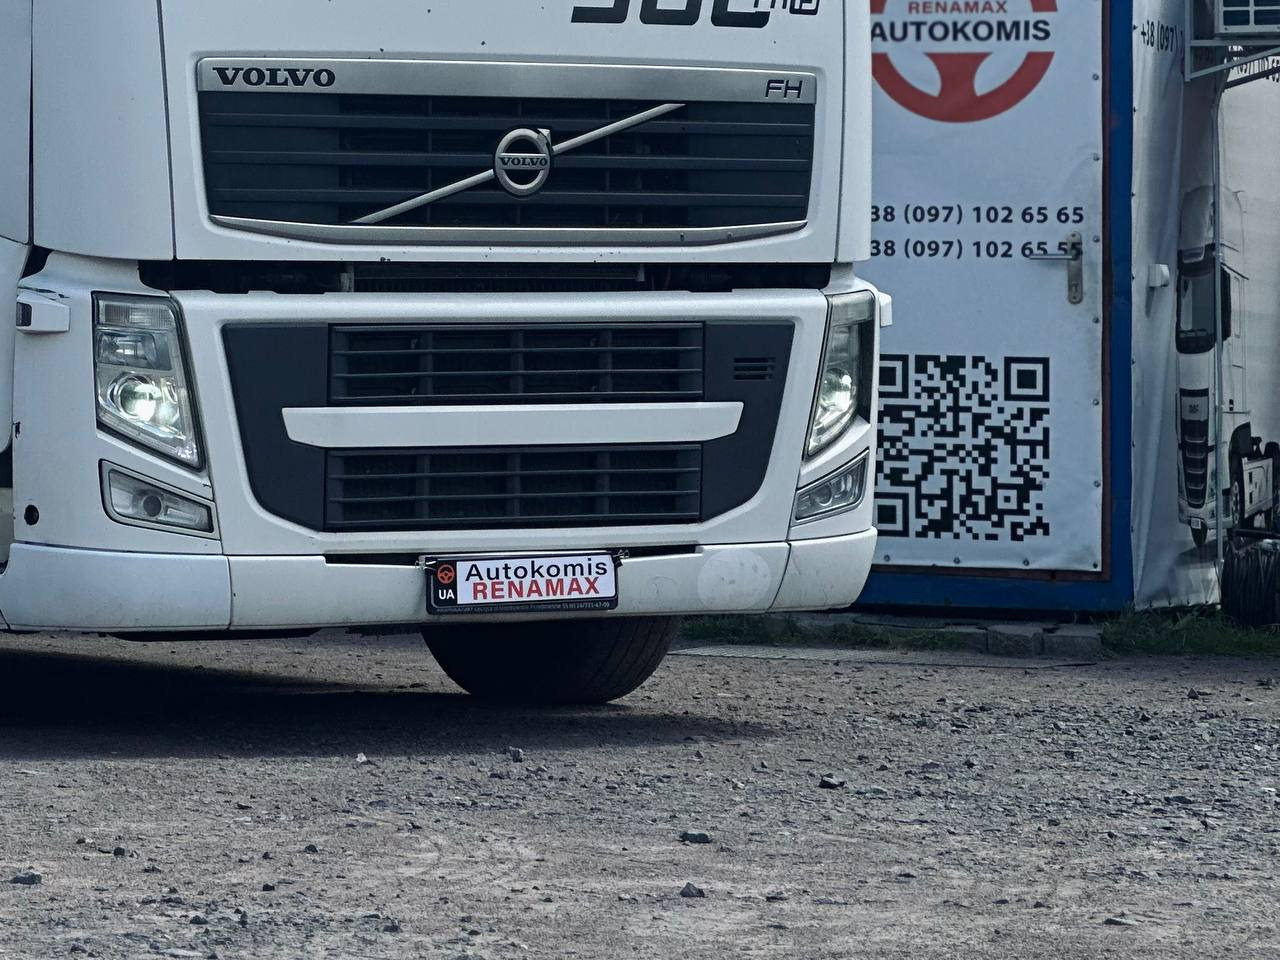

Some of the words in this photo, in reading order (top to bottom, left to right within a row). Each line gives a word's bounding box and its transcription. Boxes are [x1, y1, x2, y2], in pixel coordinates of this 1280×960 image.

[908, 0, 1008, 14] RENAMAX
[871, 20, 1051, 42] AUTOKOMIS
[213, 67, 336, 87] VOLVO
[764, 80, 803, 99] FH
[499, 156, 548, 167] VOLVO
[904, 204, 963, 224] (097)
[972, 206, 1013, 223] 102
[1021, 207, 1048, 223] 65
[1056, 207, 1084, 223] 65
[904, 238, 963, 259] (097)
[972, 241, 1013, 258] 102
[465, 558, 607, 581] Autokomis
[438, 589, 455, 600] UA
[473, 577, 600, 600] RENAMAX
